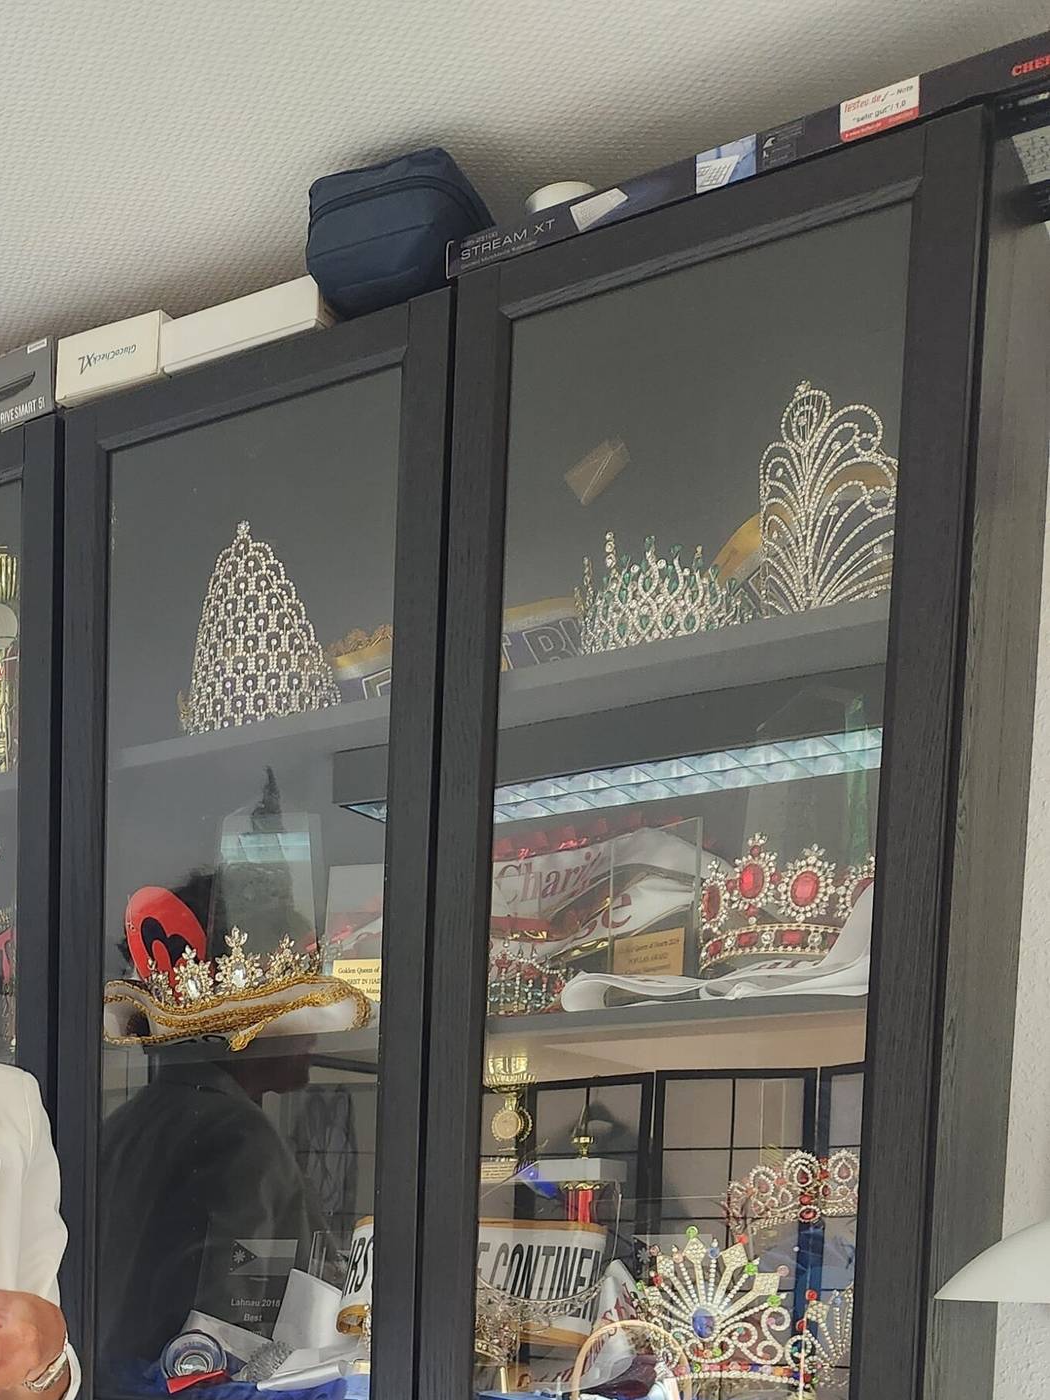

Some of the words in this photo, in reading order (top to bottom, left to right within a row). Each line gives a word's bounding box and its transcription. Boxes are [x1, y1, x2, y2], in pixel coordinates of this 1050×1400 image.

[461, 228, 528, 260] STREAM
[533, 218, 556, 236] XT
[230, 1298, 260, 1308] Lahnau
[243, 1313, 263, 1322] Best
